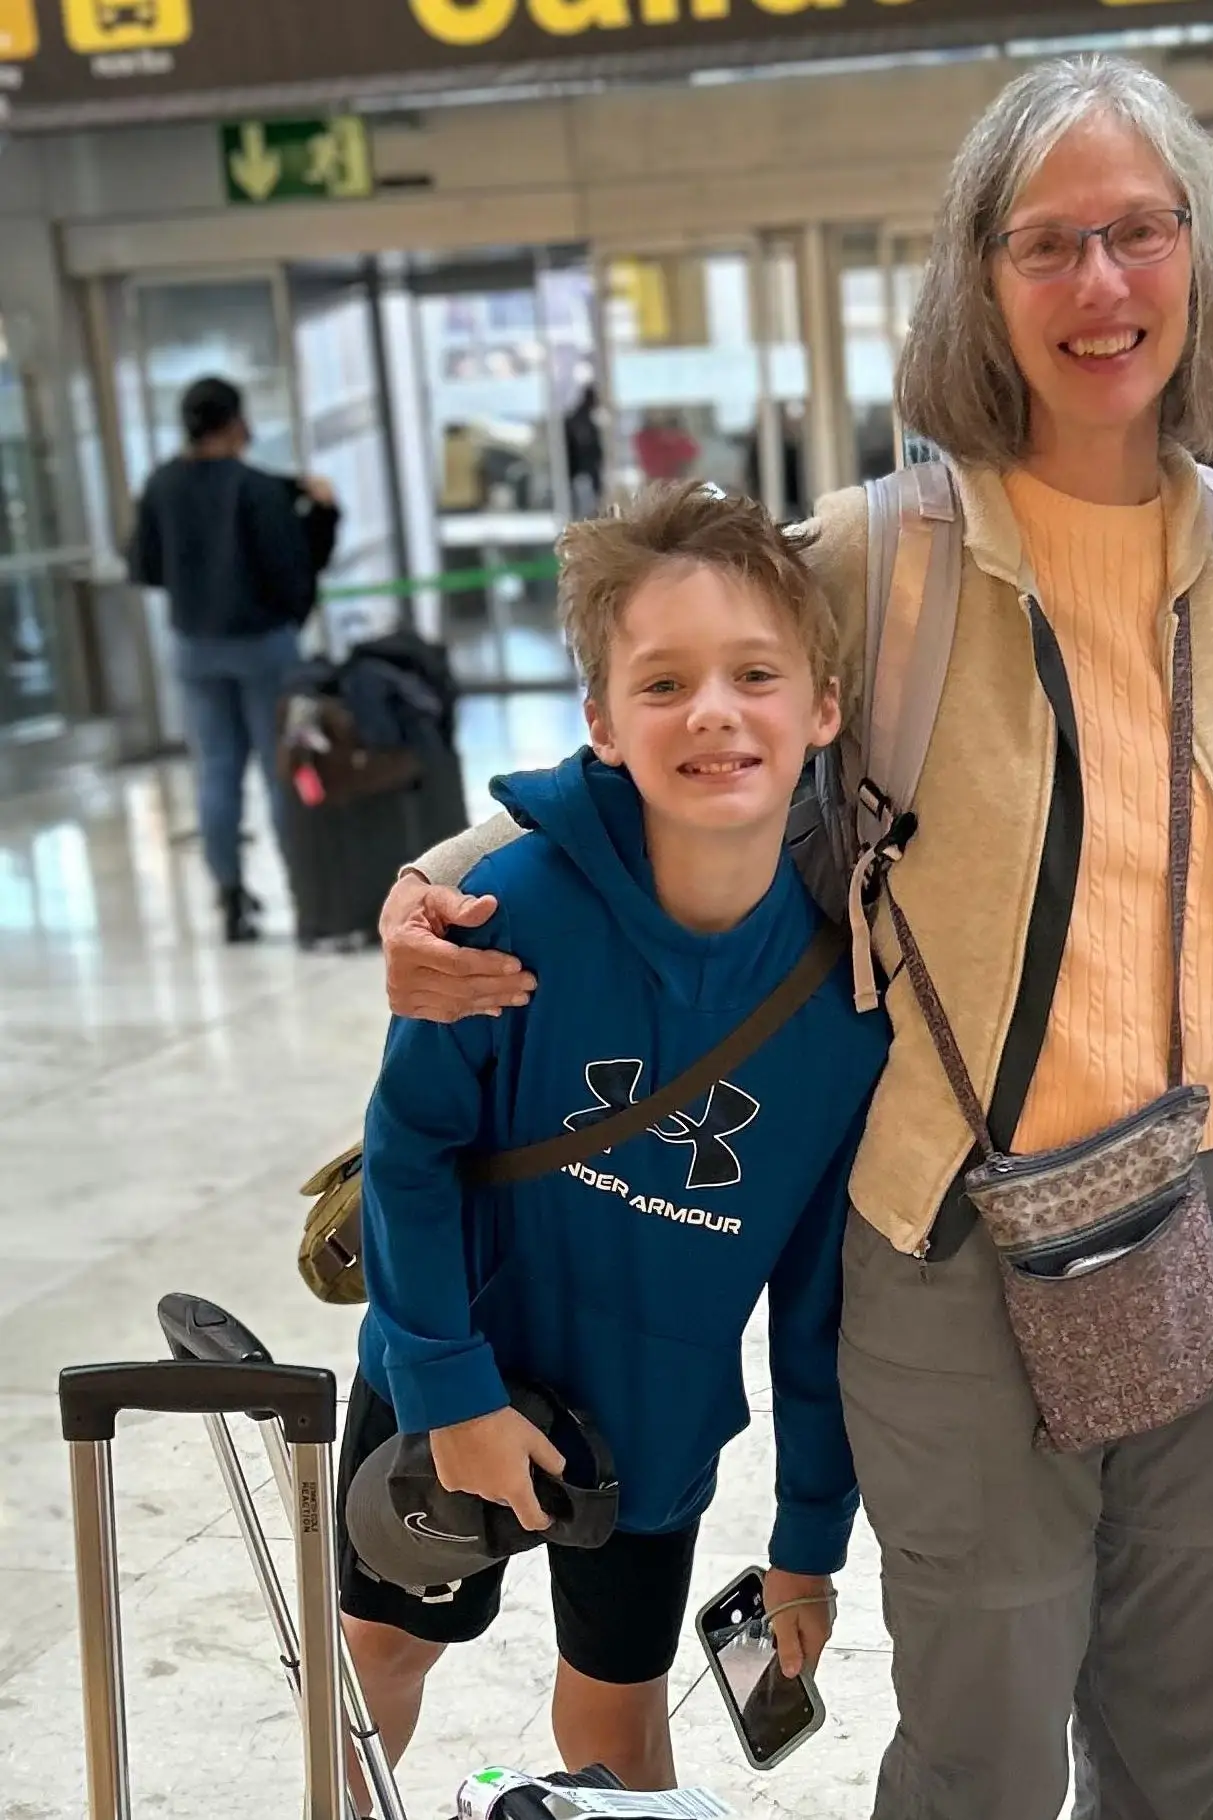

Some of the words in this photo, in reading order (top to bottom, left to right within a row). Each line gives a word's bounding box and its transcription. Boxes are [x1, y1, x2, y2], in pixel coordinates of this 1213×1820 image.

[560, 1162, 630, 1198] NDER
[629, 1195, 742, 1234] ARMOUR
[302, 1481, 311, 1533] REACTION
